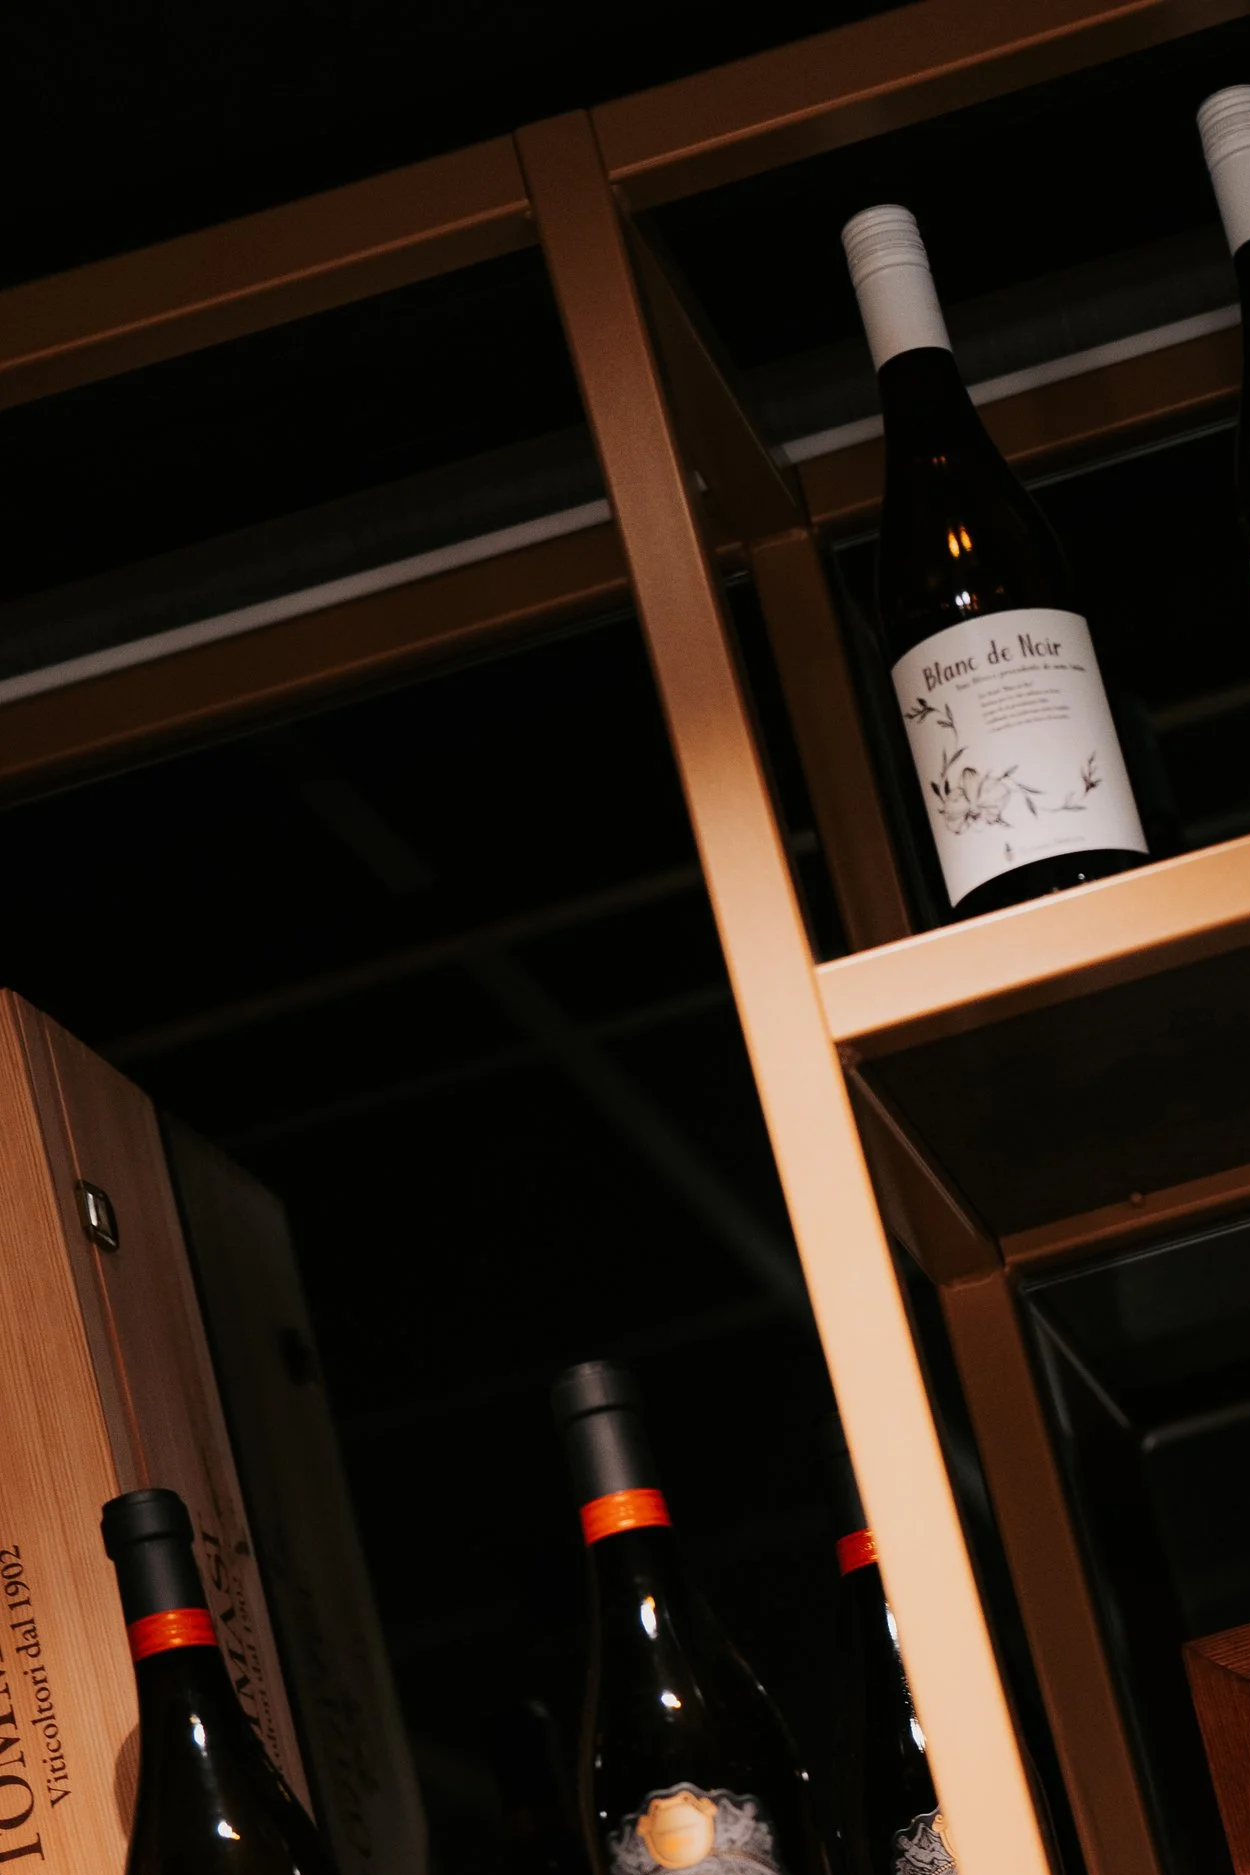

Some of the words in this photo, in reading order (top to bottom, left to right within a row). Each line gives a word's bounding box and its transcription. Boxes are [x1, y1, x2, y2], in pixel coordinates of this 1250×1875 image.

[923, 656, 977, 692] Blanc
[987, 640, 1014, 665] de
[1017, 634, 1062, 660] Noir
[0, 1545, 31, 1612] 1902
[10, 1621, 42, 1657] dal
[24, 1662, 72, 1808] Viticoltori
